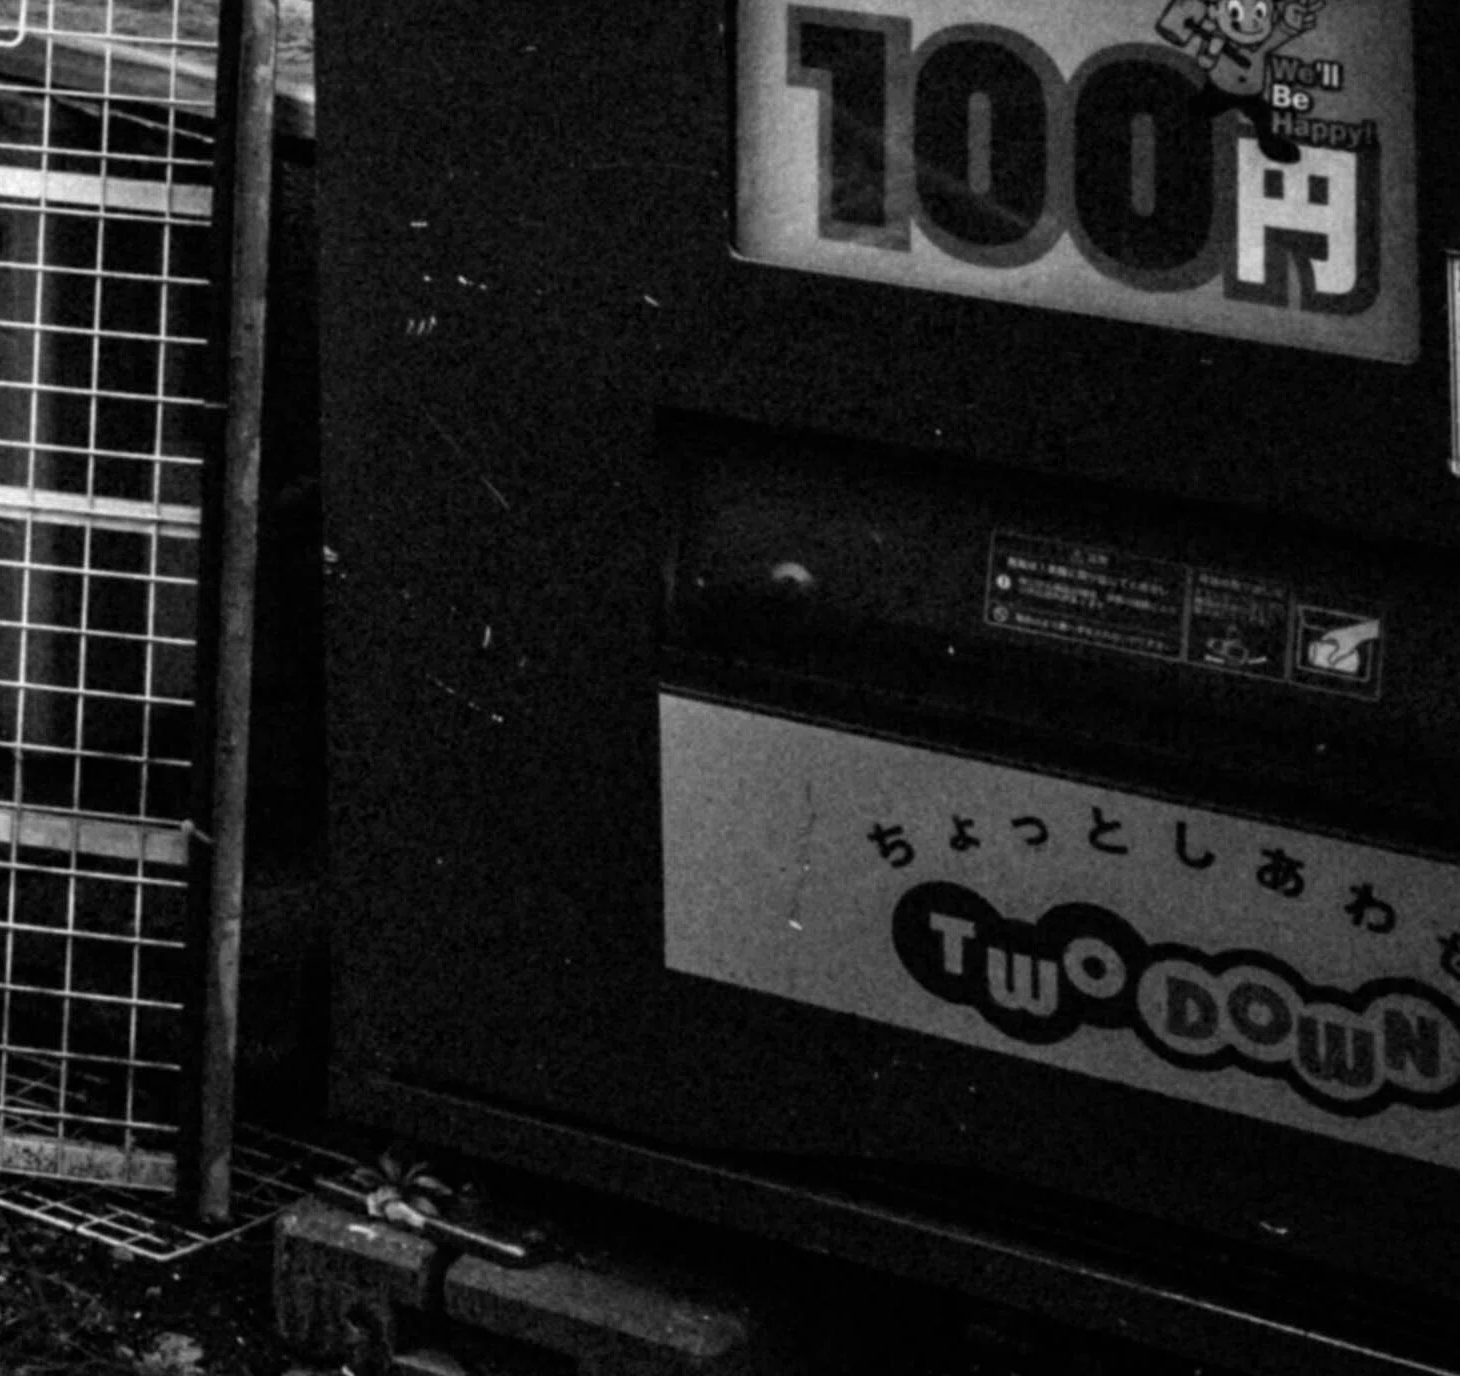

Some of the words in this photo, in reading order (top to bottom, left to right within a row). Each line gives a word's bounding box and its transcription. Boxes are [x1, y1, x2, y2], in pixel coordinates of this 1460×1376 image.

[1270, 54, 1344, 89] We'll
[1270, 84, 1312, 113] Be
[1271, 111, 1377, 148] Happy!
[788, 5, 1380, 315] 100円
